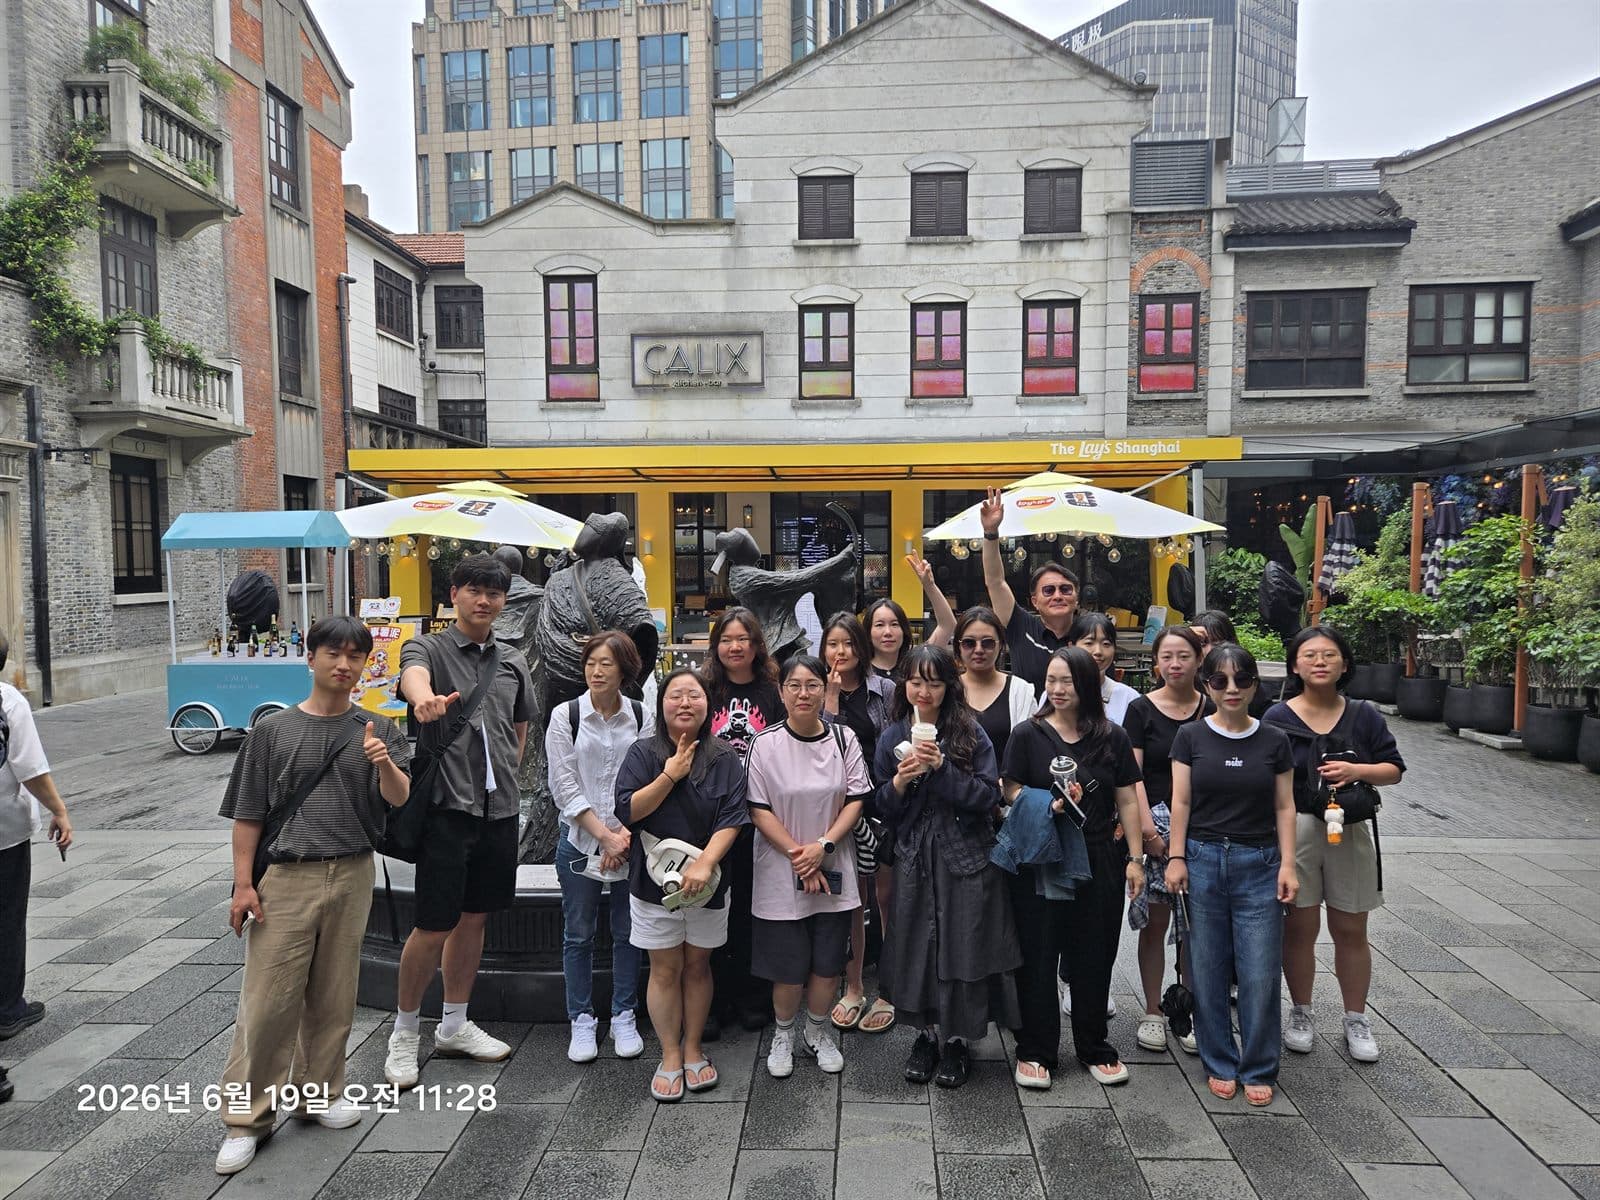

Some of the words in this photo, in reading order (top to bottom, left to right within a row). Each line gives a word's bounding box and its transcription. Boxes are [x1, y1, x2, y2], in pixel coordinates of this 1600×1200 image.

[643, 342, 749, 375] CALIX
[1050, 443, 1075, 455] The
[1078, 441, 1112, 460] Lay's
[1115, 440, 1180, 456] Shanghai
[430, 620, 448, 630] Lay's
